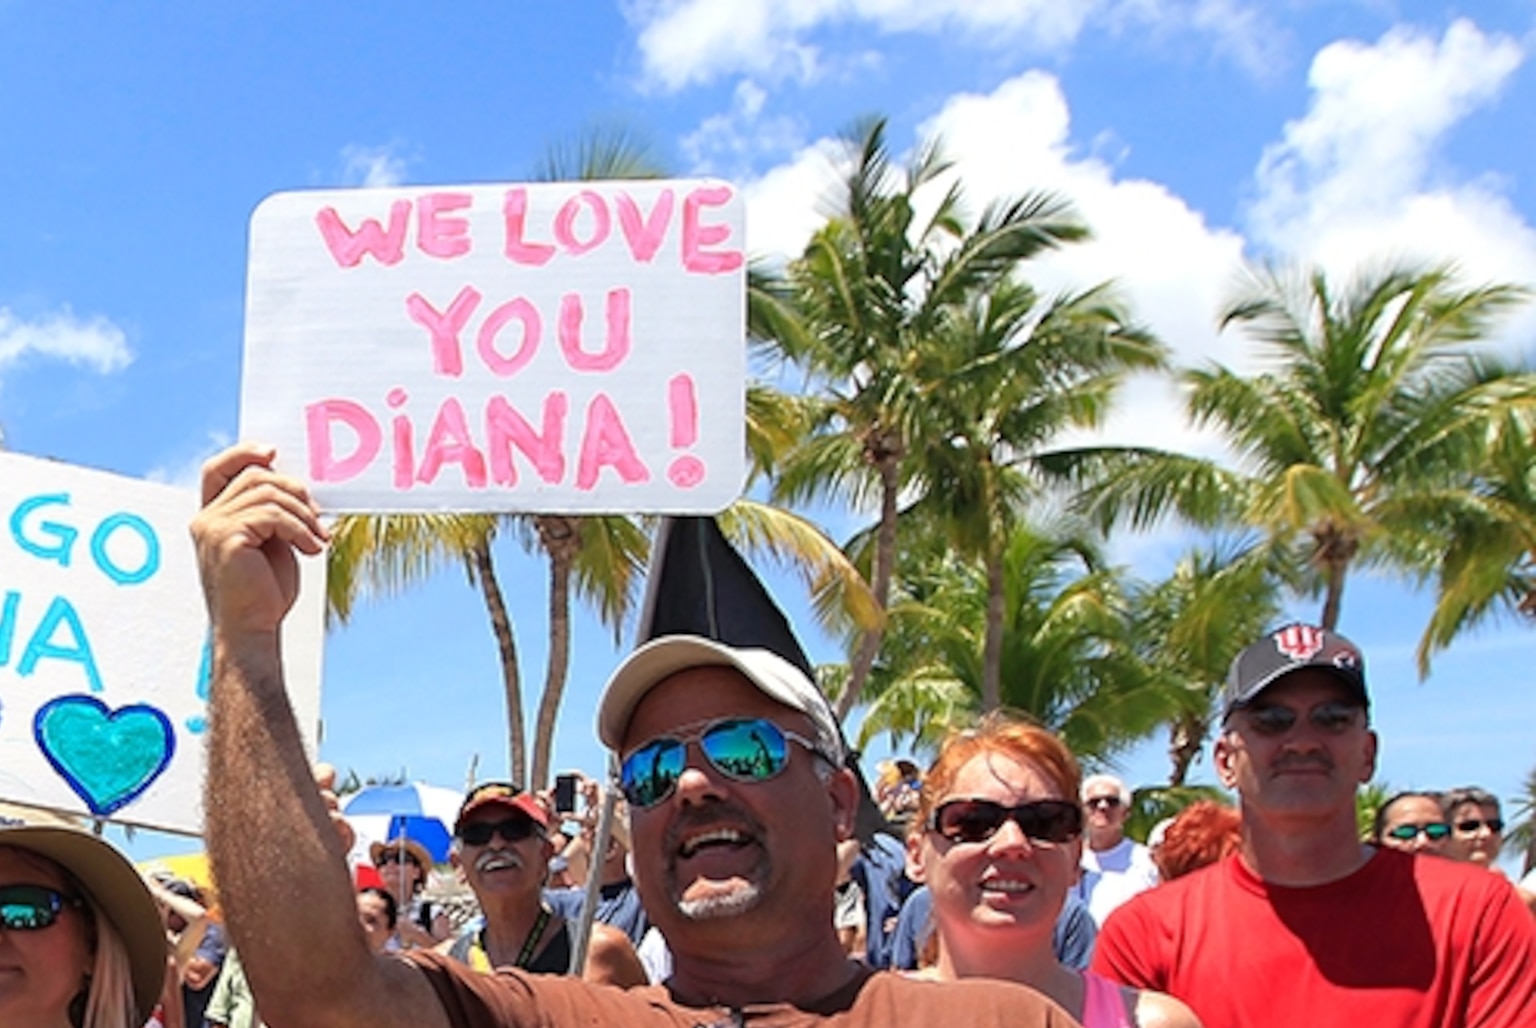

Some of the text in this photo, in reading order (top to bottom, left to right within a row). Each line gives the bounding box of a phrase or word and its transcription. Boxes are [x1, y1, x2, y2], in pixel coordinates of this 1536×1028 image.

[315, 186, 744, 275] WE LOVE
[405, 285, 632, 378] YOU
[8, 491, 161, 586] GO
